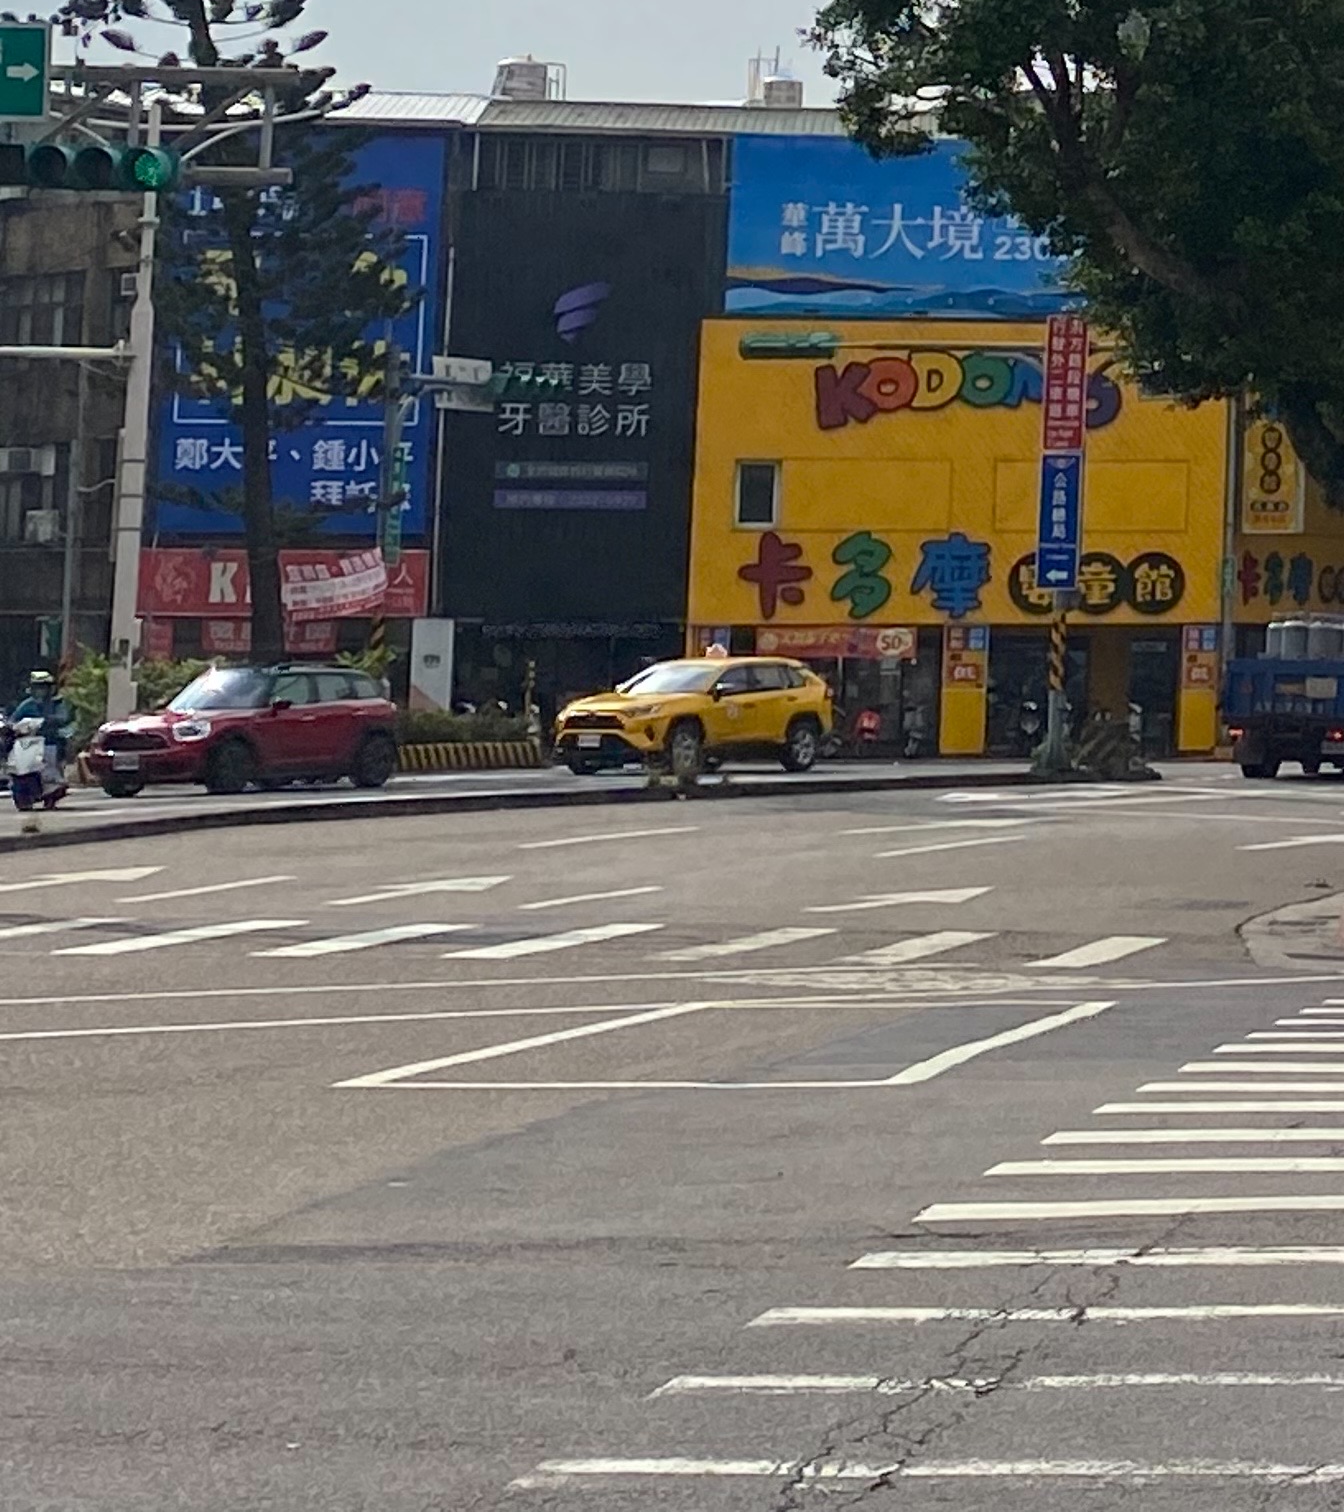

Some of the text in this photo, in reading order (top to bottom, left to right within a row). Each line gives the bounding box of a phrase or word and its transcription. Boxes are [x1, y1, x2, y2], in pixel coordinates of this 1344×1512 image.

[812, 201, 985, 260] 萬大境
[498, 402, 650, 437] 牙醫診所
